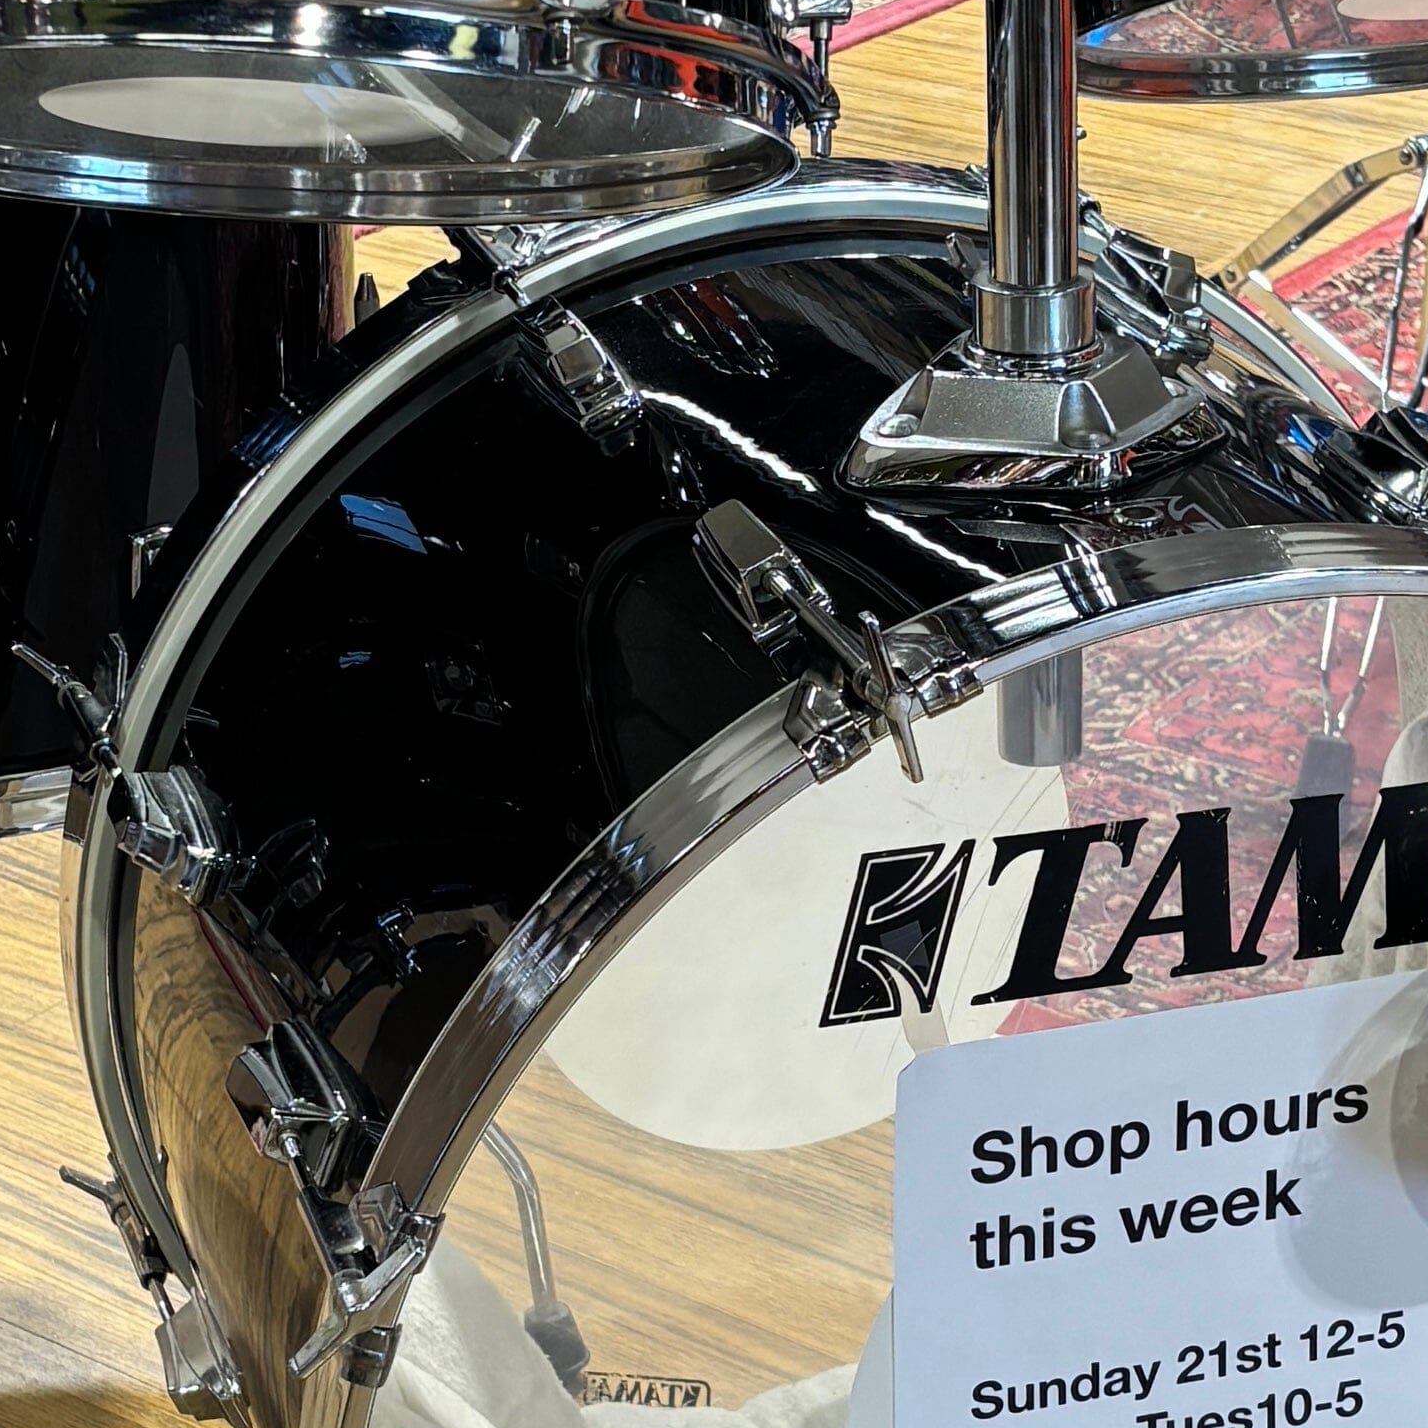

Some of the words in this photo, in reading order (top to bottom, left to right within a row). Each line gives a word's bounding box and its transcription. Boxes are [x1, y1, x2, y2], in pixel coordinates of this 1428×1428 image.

[971, 1122, 1150, 1185] Shop
[1177, 1084, 1369, 1152] hours
[969, 1207, 1096, 1270] this
[1119, 1168, 1302, 1244] week
[971, 1361, 1162, 1420] Sunday
[1176, 1325, 1282, 1385] 21st
[1299, 1310, 1406, 1362] 12-5
